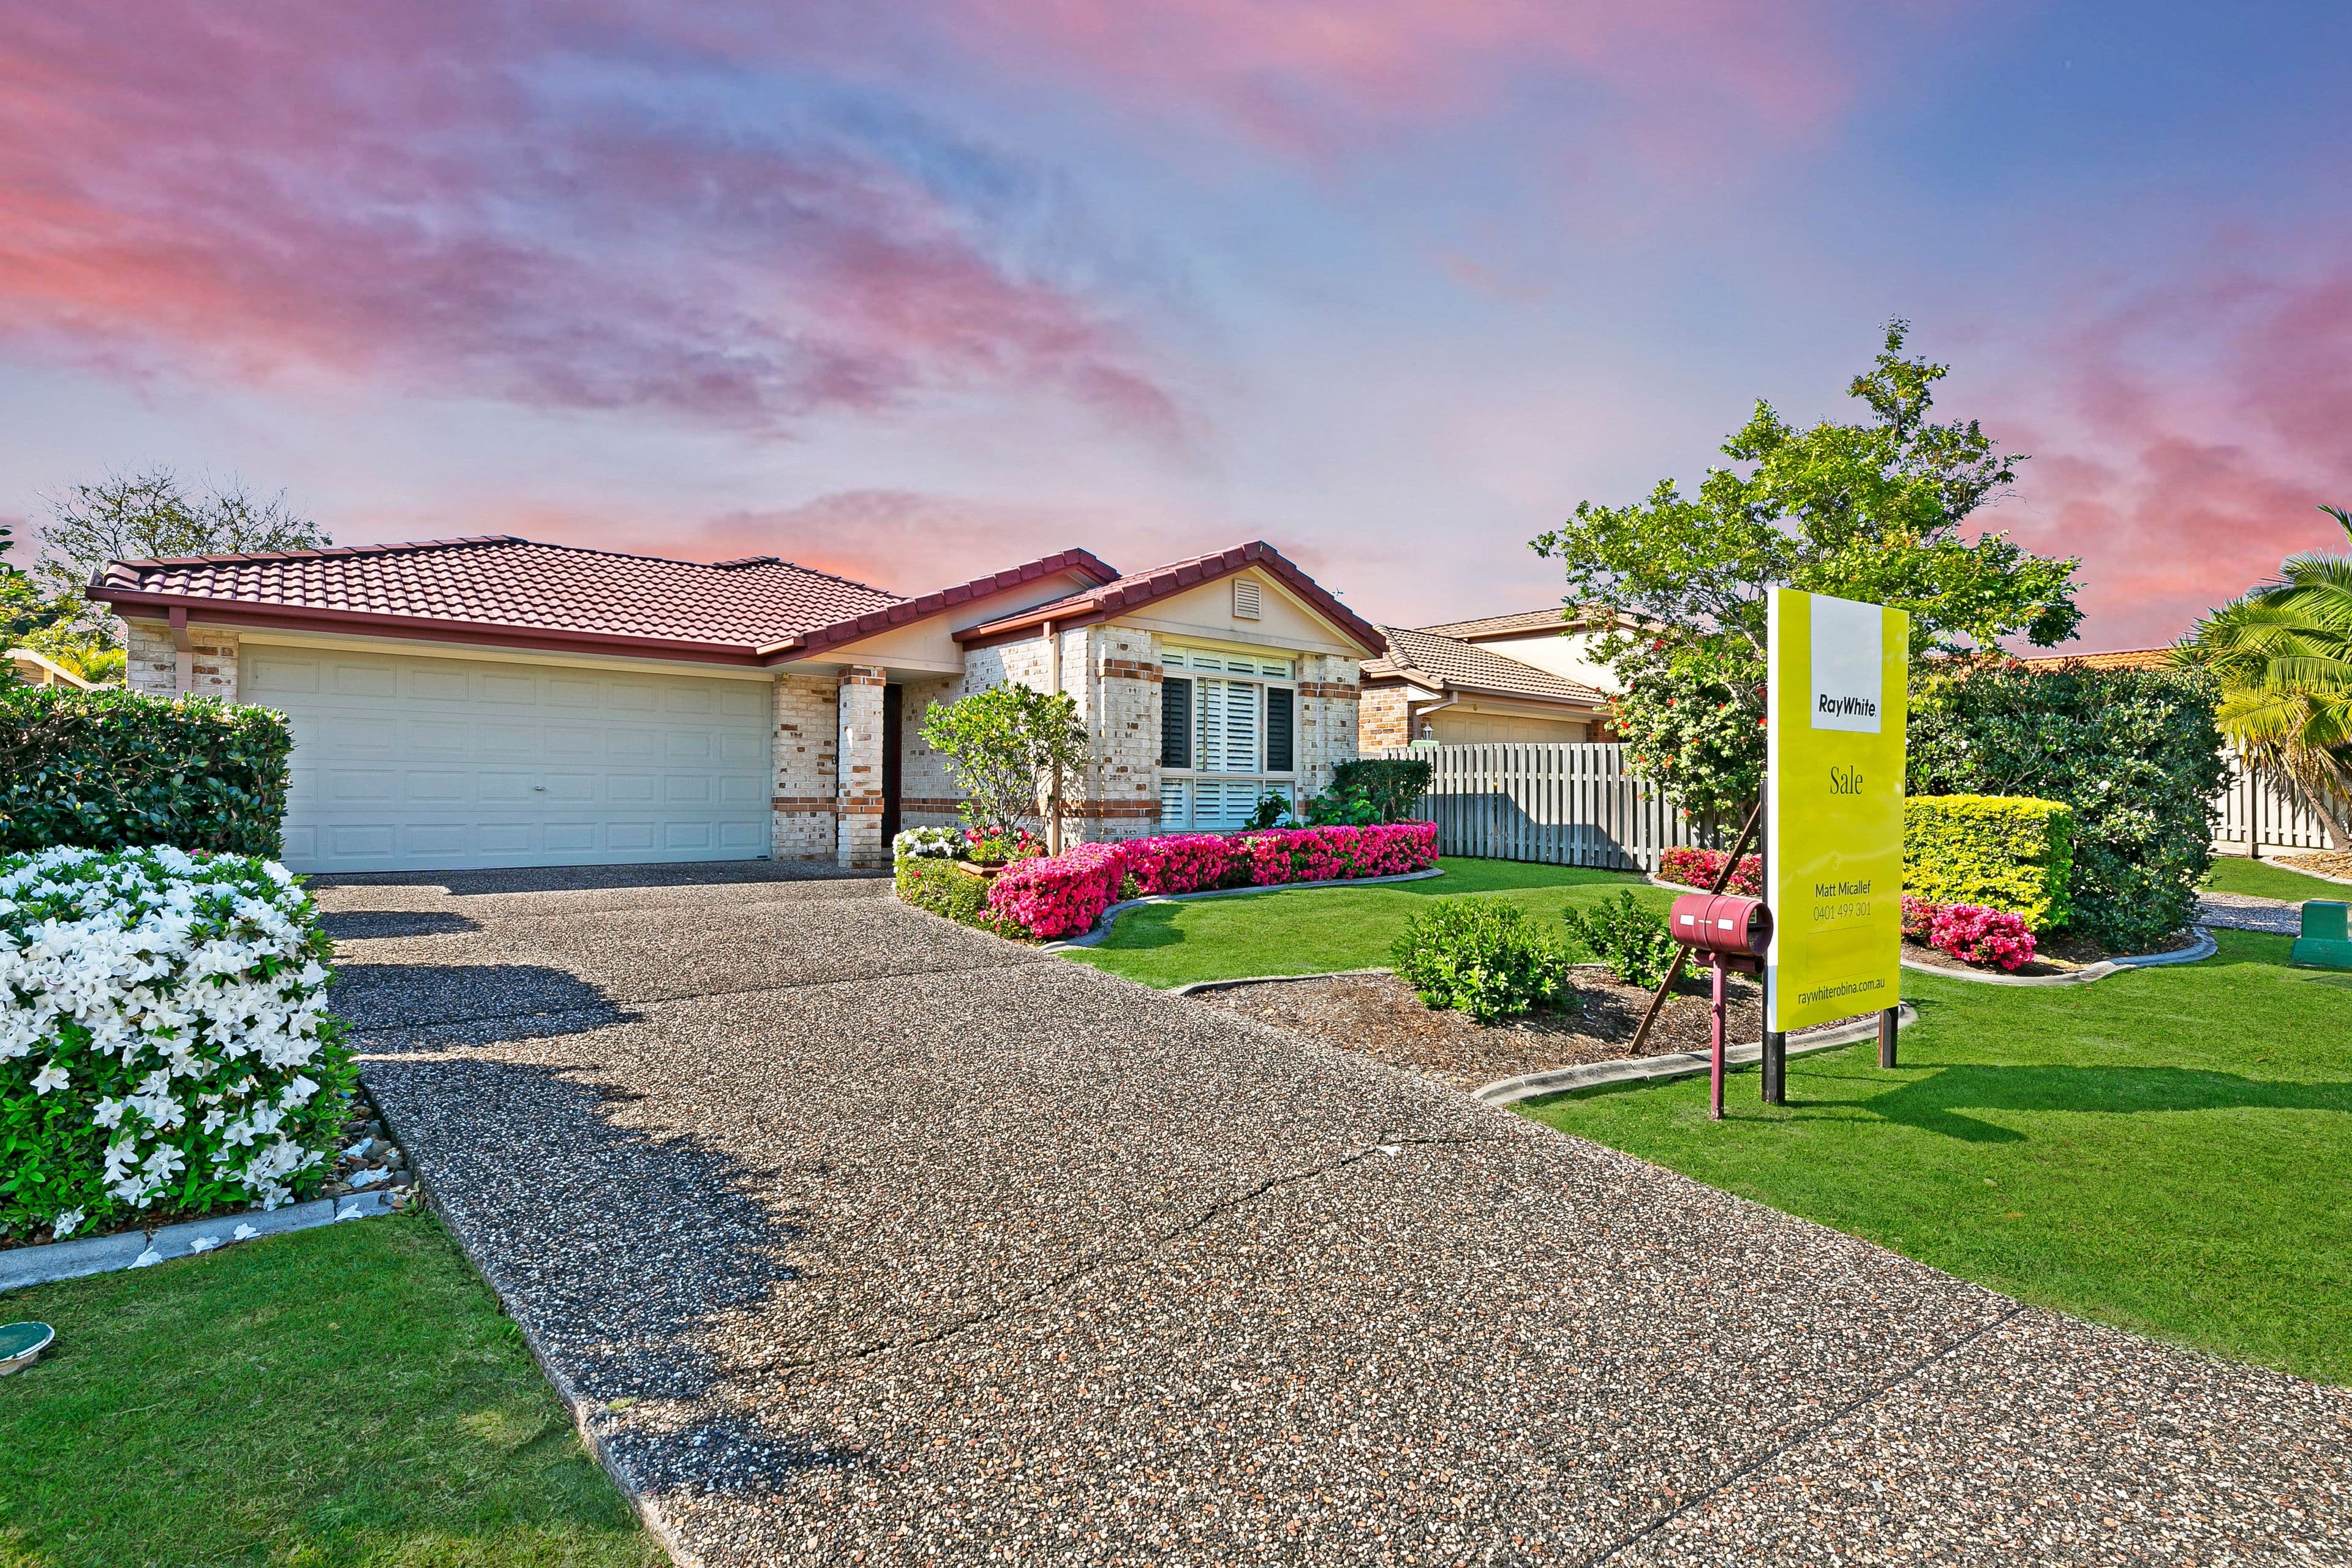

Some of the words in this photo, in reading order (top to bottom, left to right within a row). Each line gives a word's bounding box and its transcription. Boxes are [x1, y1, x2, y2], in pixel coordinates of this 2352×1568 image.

[1830, 765, 1863, 794] Sale
[1815, 883, 1836, 898] Matt
[1838, 880, 1871, 895] Micallef
[1814, 905, 1835, 921] 0401
[1838, 903, 1853, 918] 499
[1856, 902, 1871, 916] 301
[1798, 978, 1885, 1006] raywhiterobina.com.au
